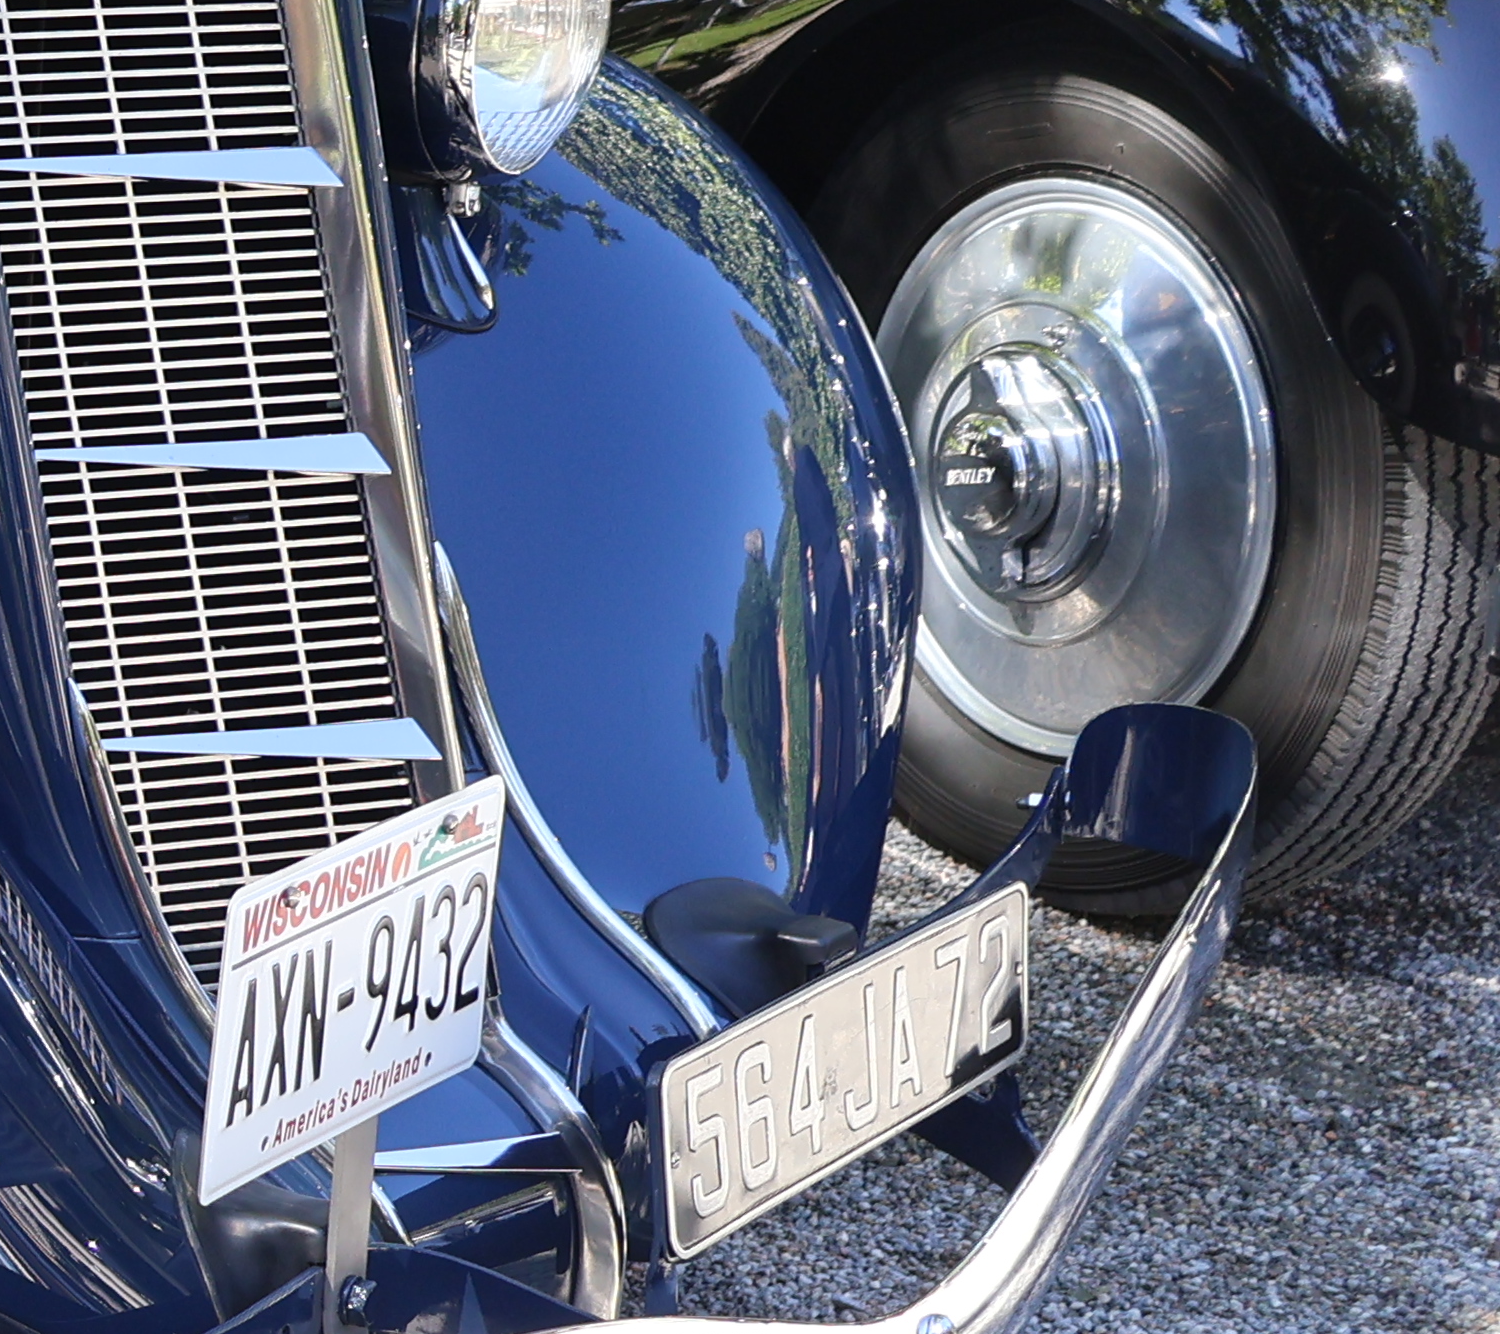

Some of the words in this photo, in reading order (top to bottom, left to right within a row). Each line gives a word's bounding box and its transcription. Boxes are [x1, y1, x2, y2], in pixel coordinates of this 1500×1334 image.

[944, 466, 996, 487] BENTLEY
[241, 841, 392, 954] WISCONSIN
[225, 872, 488, 1129] AXN-9432
[272, 1092, 349, 1150] America's
[350, 1047, 423, 1108] Dairyland
[685, 1013, 826, 1219] 564
[843, 965, 923, 1132] JA
[934, 915, 1014, 1078] 72
